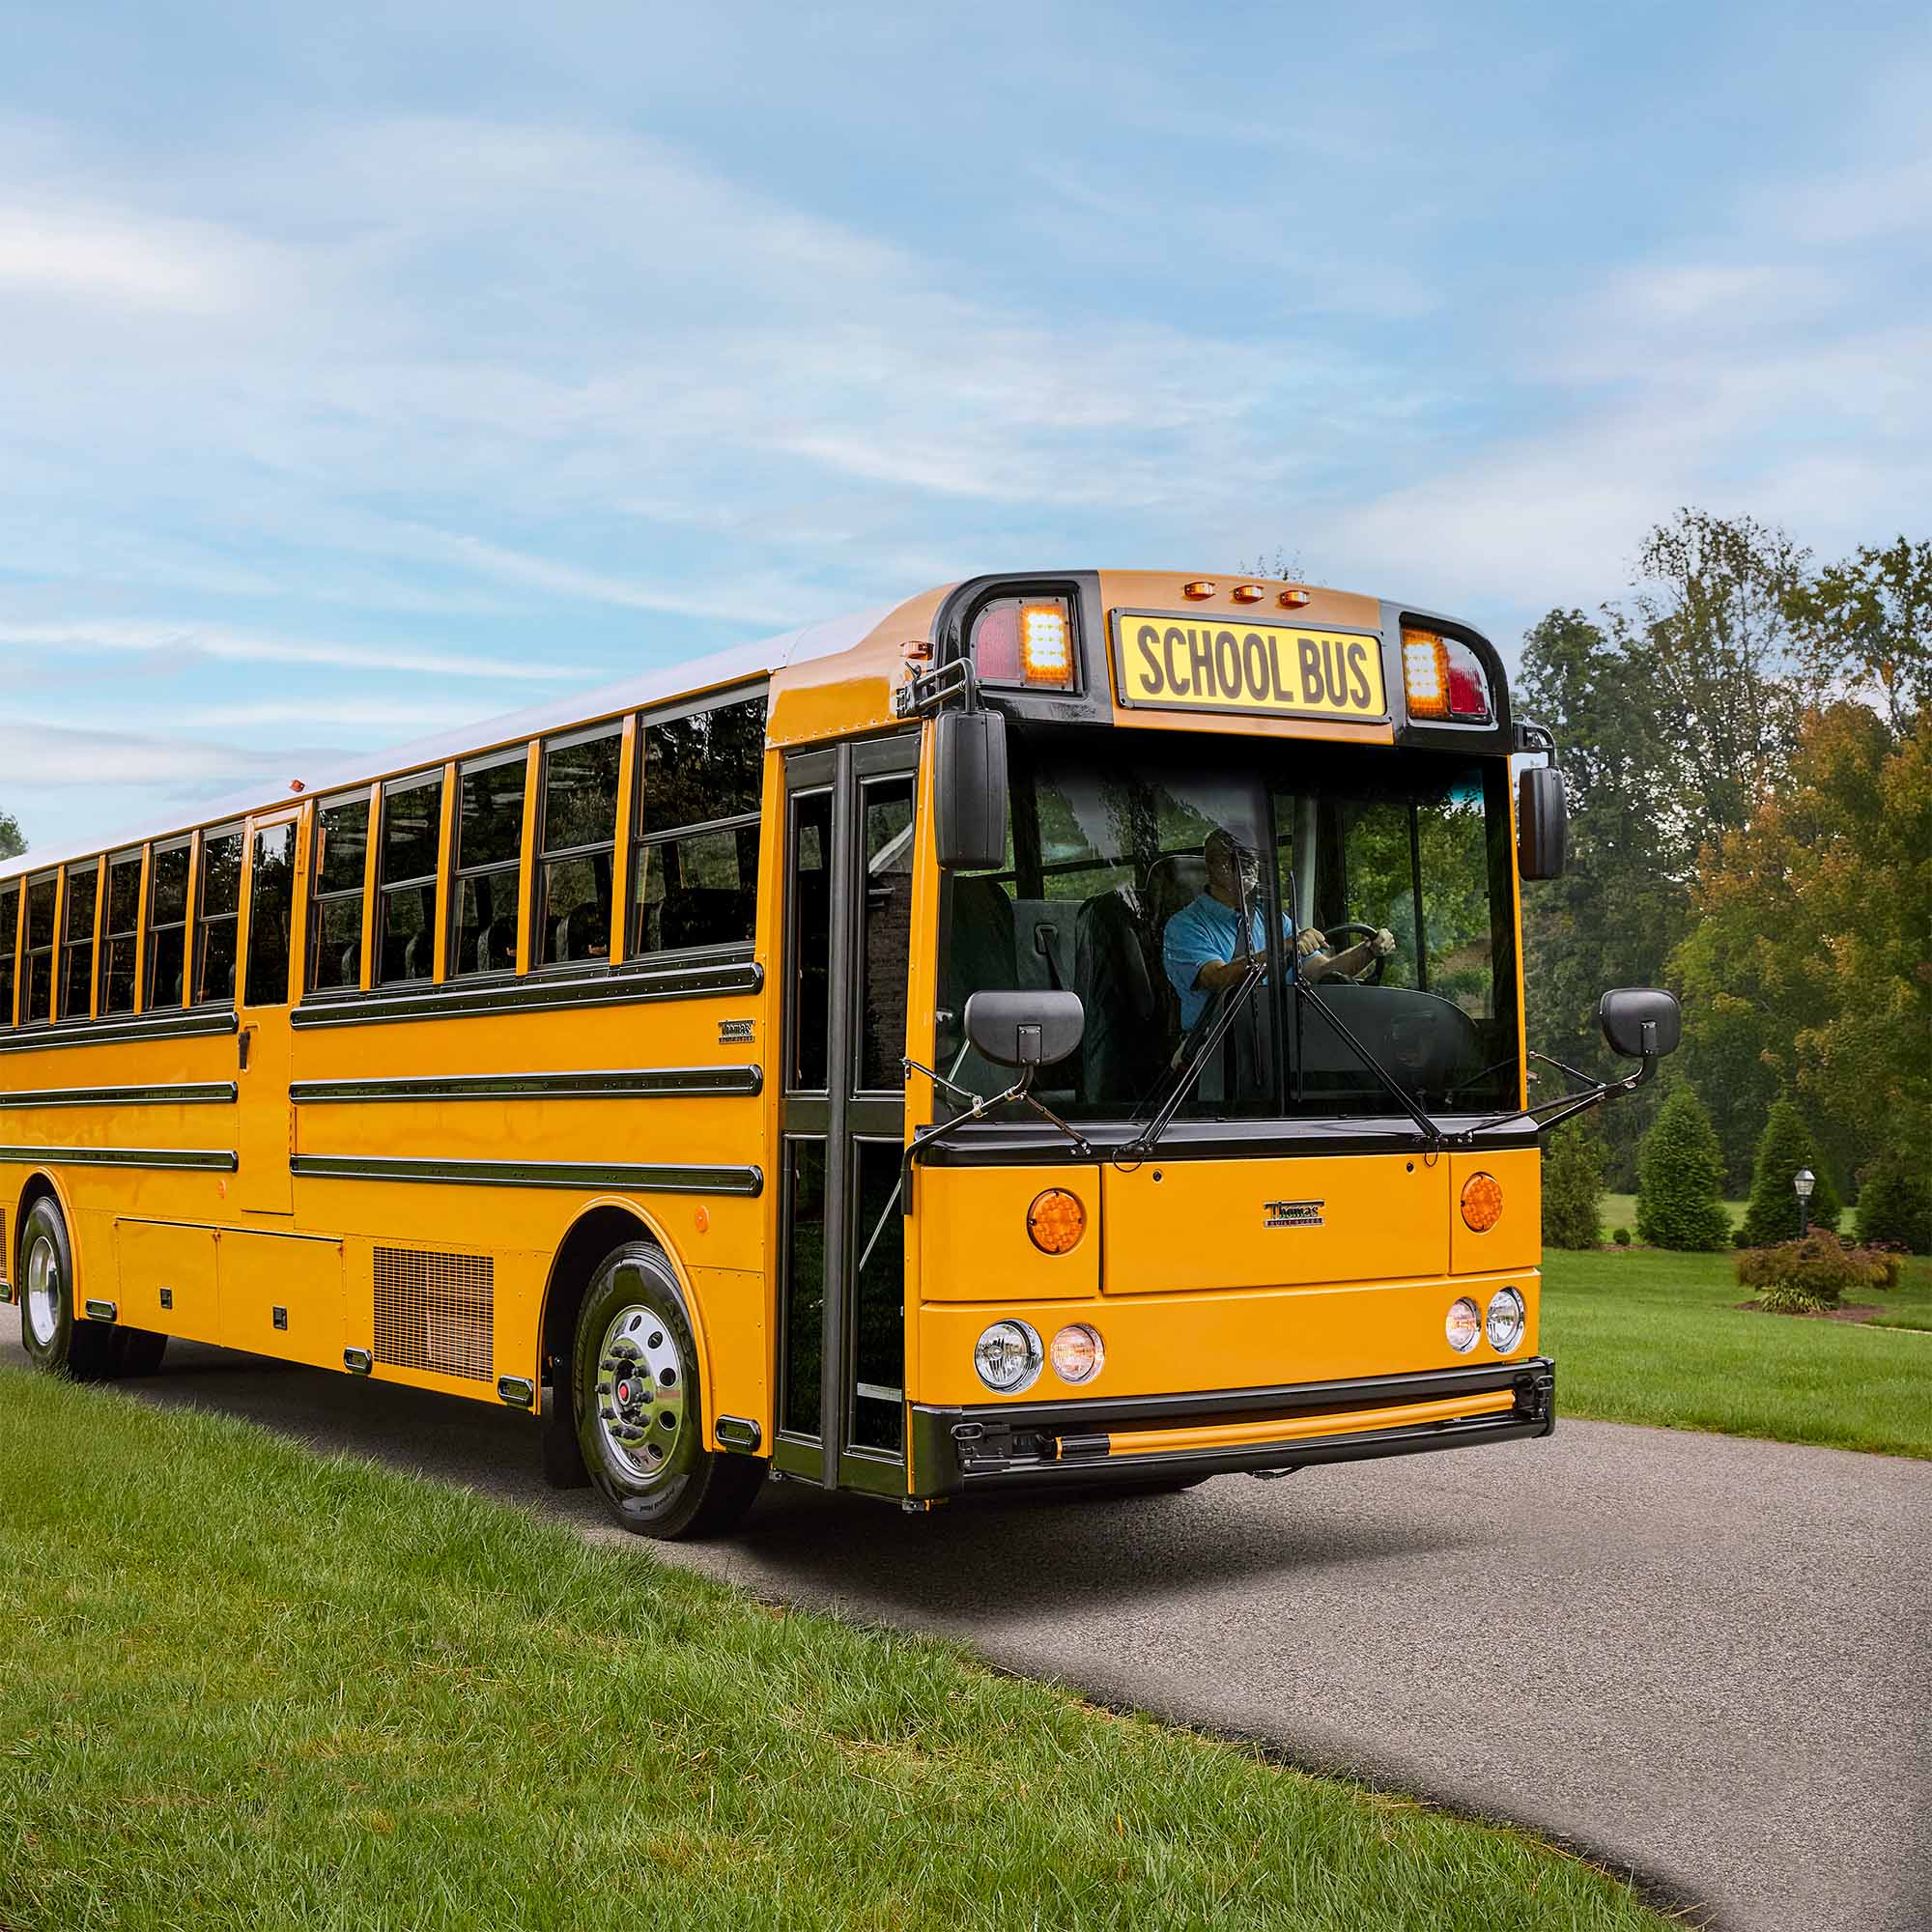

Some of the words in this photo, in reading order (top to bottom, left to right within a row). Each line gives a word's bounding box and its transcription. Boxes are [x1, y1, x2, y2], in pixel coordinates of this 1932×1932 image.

[1137, 625, 1294, 702] SCHOOL
[1297, 638, 1372, 709] BUS
[1264, 1201, 1324, 1219] Thomas
